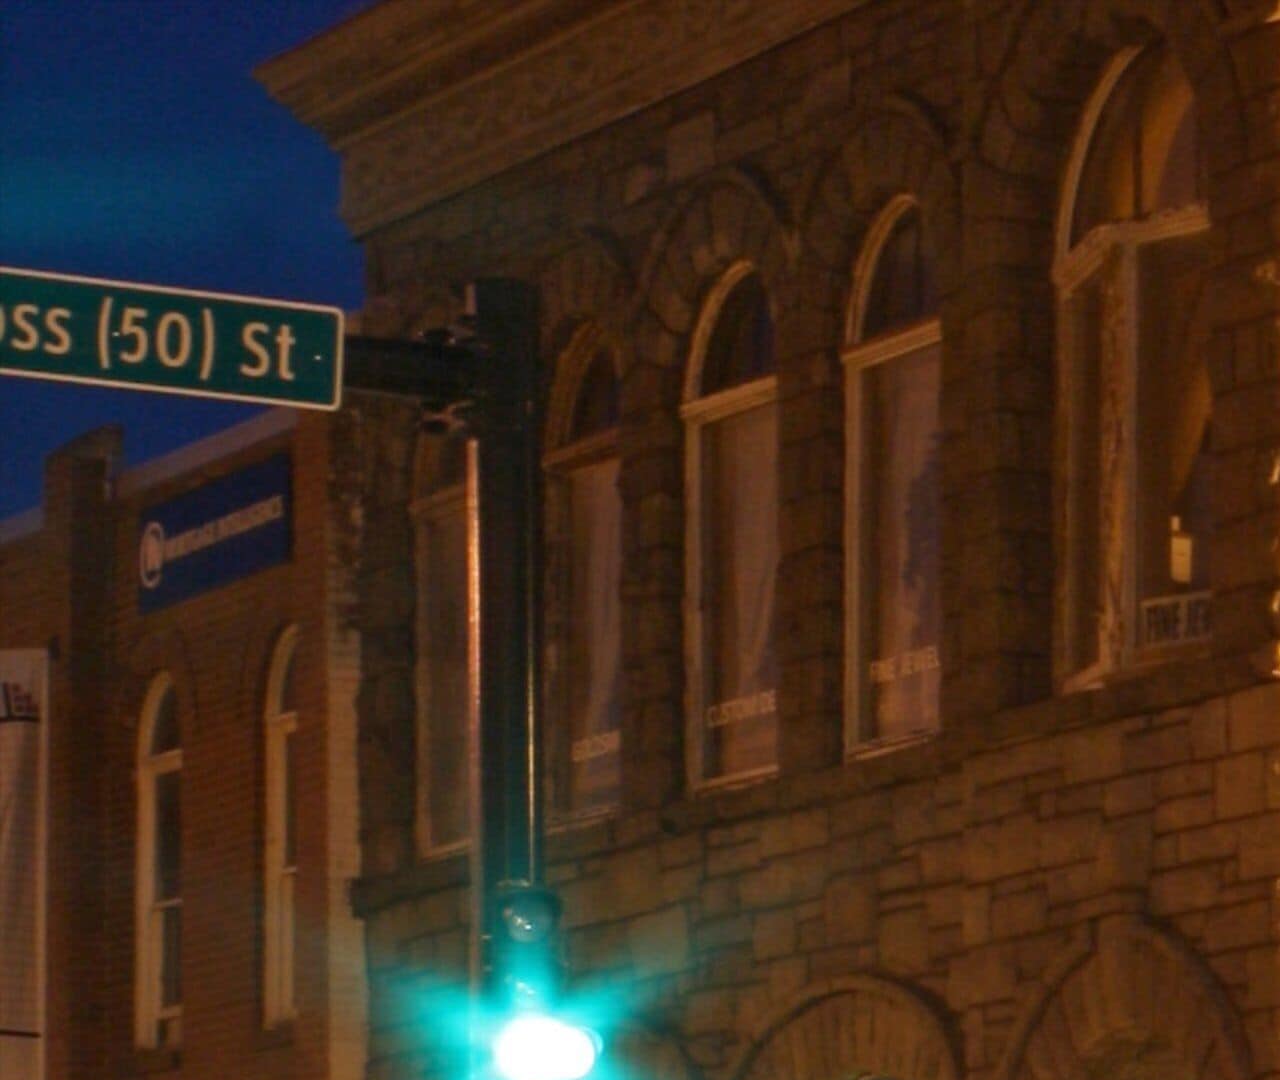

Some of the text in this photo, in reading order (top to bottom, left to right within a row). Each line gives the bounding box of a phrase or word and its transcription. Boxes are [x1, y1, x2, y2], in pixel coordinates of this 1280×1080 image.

[0, 296, 296, 381] ss (50) St
